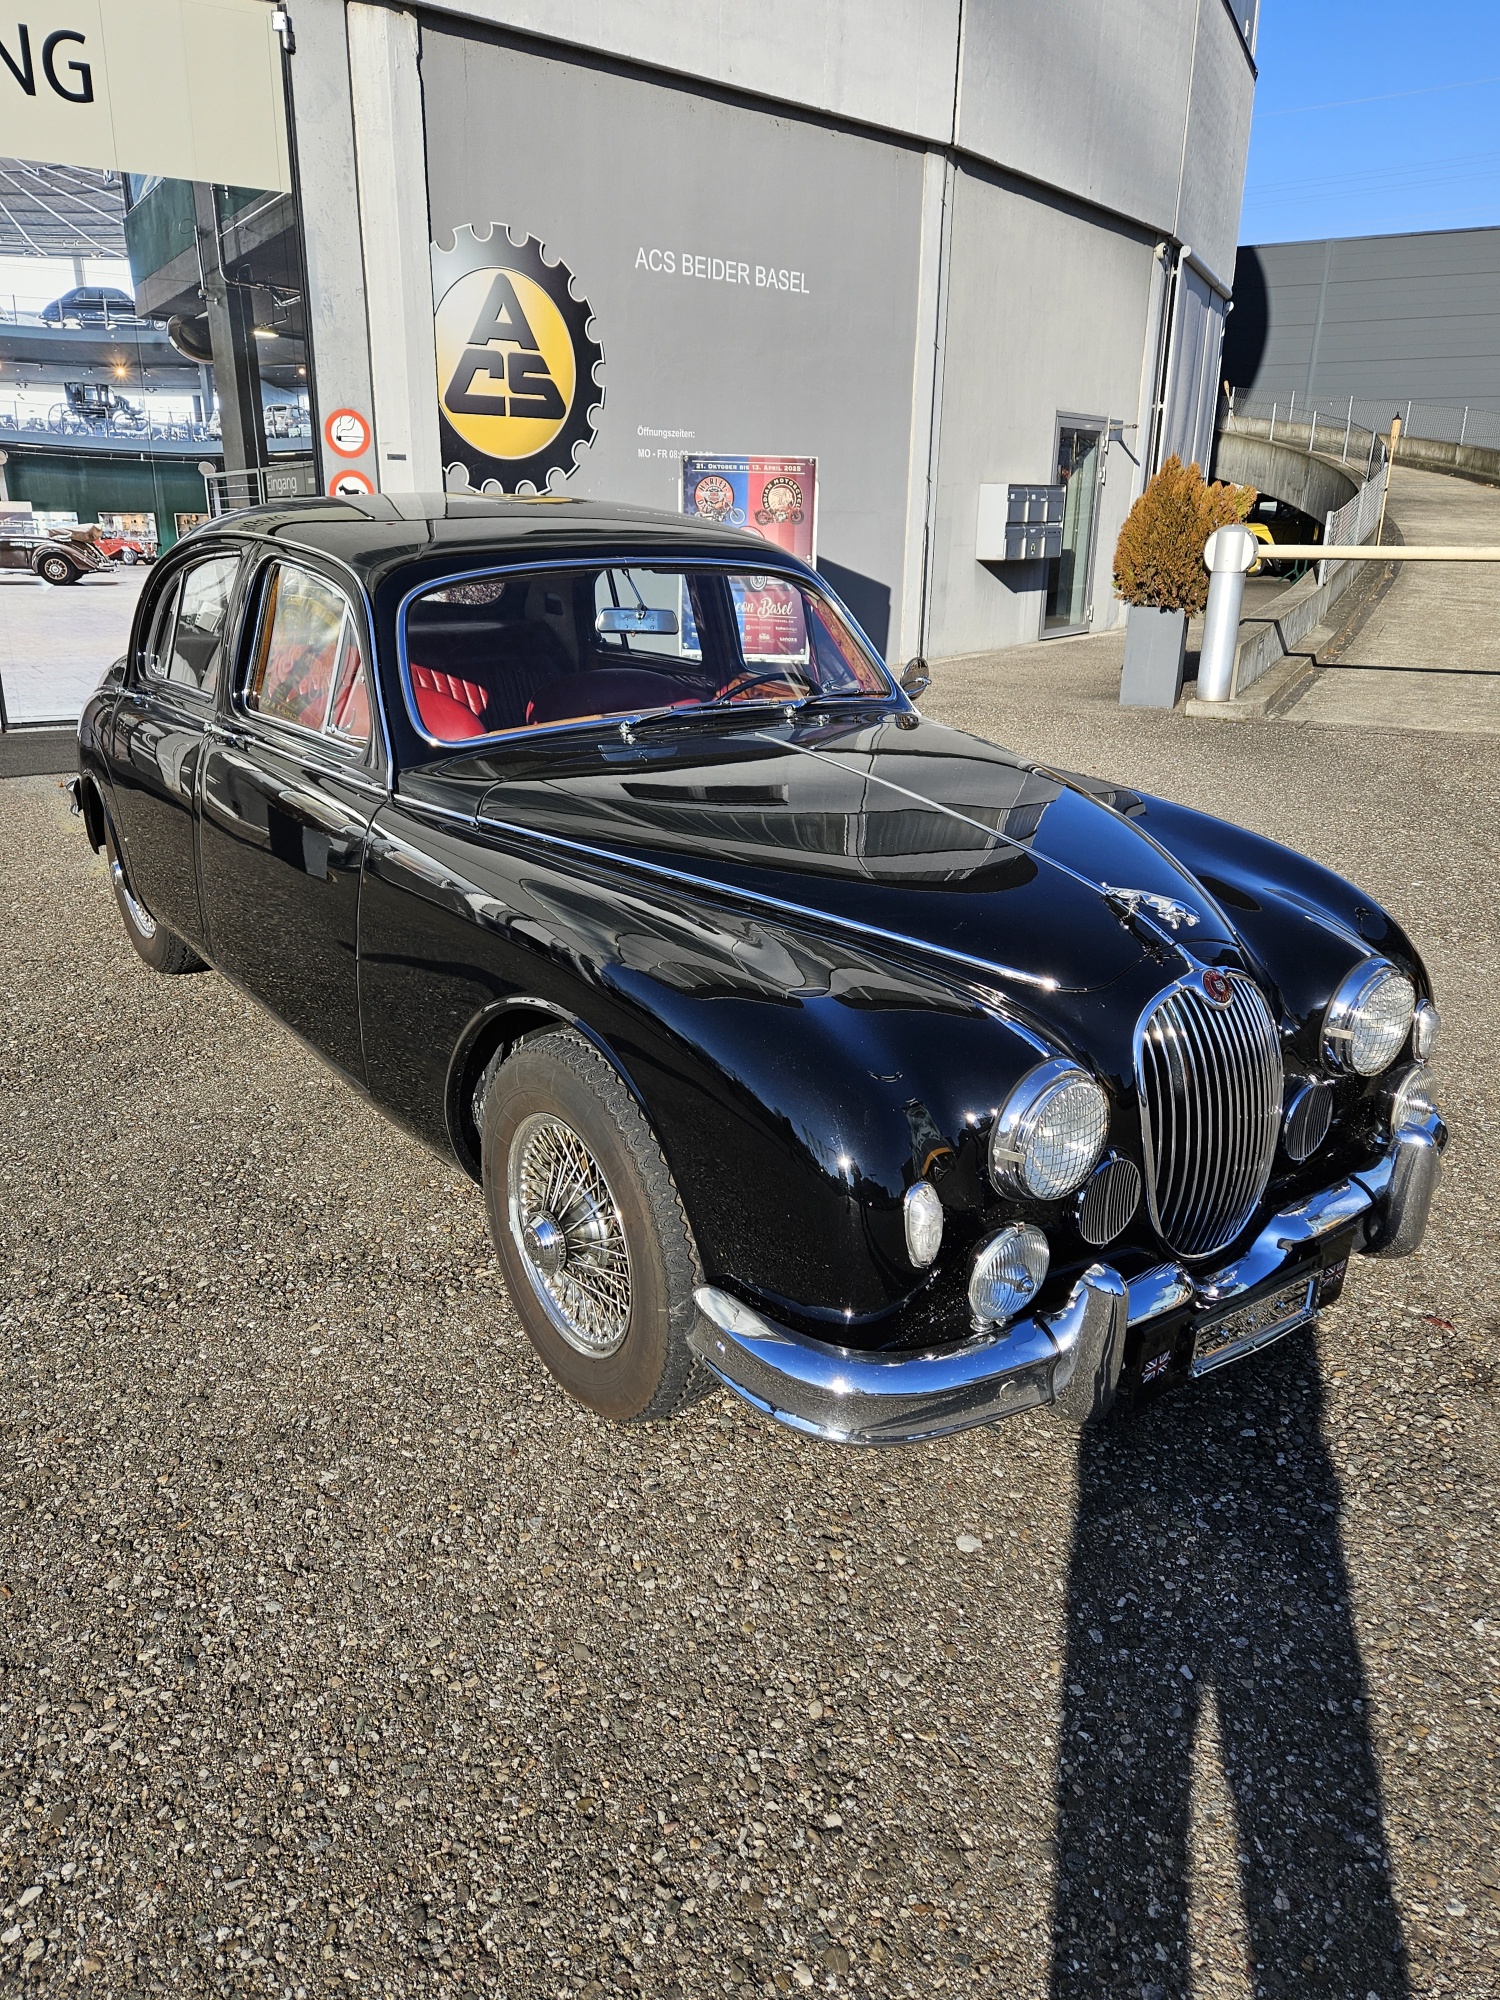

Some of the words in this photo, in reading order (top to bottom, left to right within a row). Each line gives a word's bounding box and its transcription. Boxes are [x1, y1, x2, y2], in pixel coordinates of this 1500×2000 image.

[634, 246, 676, 274] ACS
[682, 253, 750, 285] BEIDER
[755, 265, 810, 294] BASEL
[637, 425, 696, 439] Öffnungszeiten:
[637, 448, 651, 458] MO
[657, 449, 668, 459] FR
[266, 475, 298, 495] Eingang
[773, 478, 802, 508] MOTORCYCL
[734, 601, 755, 613] eon
[757, 597, 793, 619] Basel
